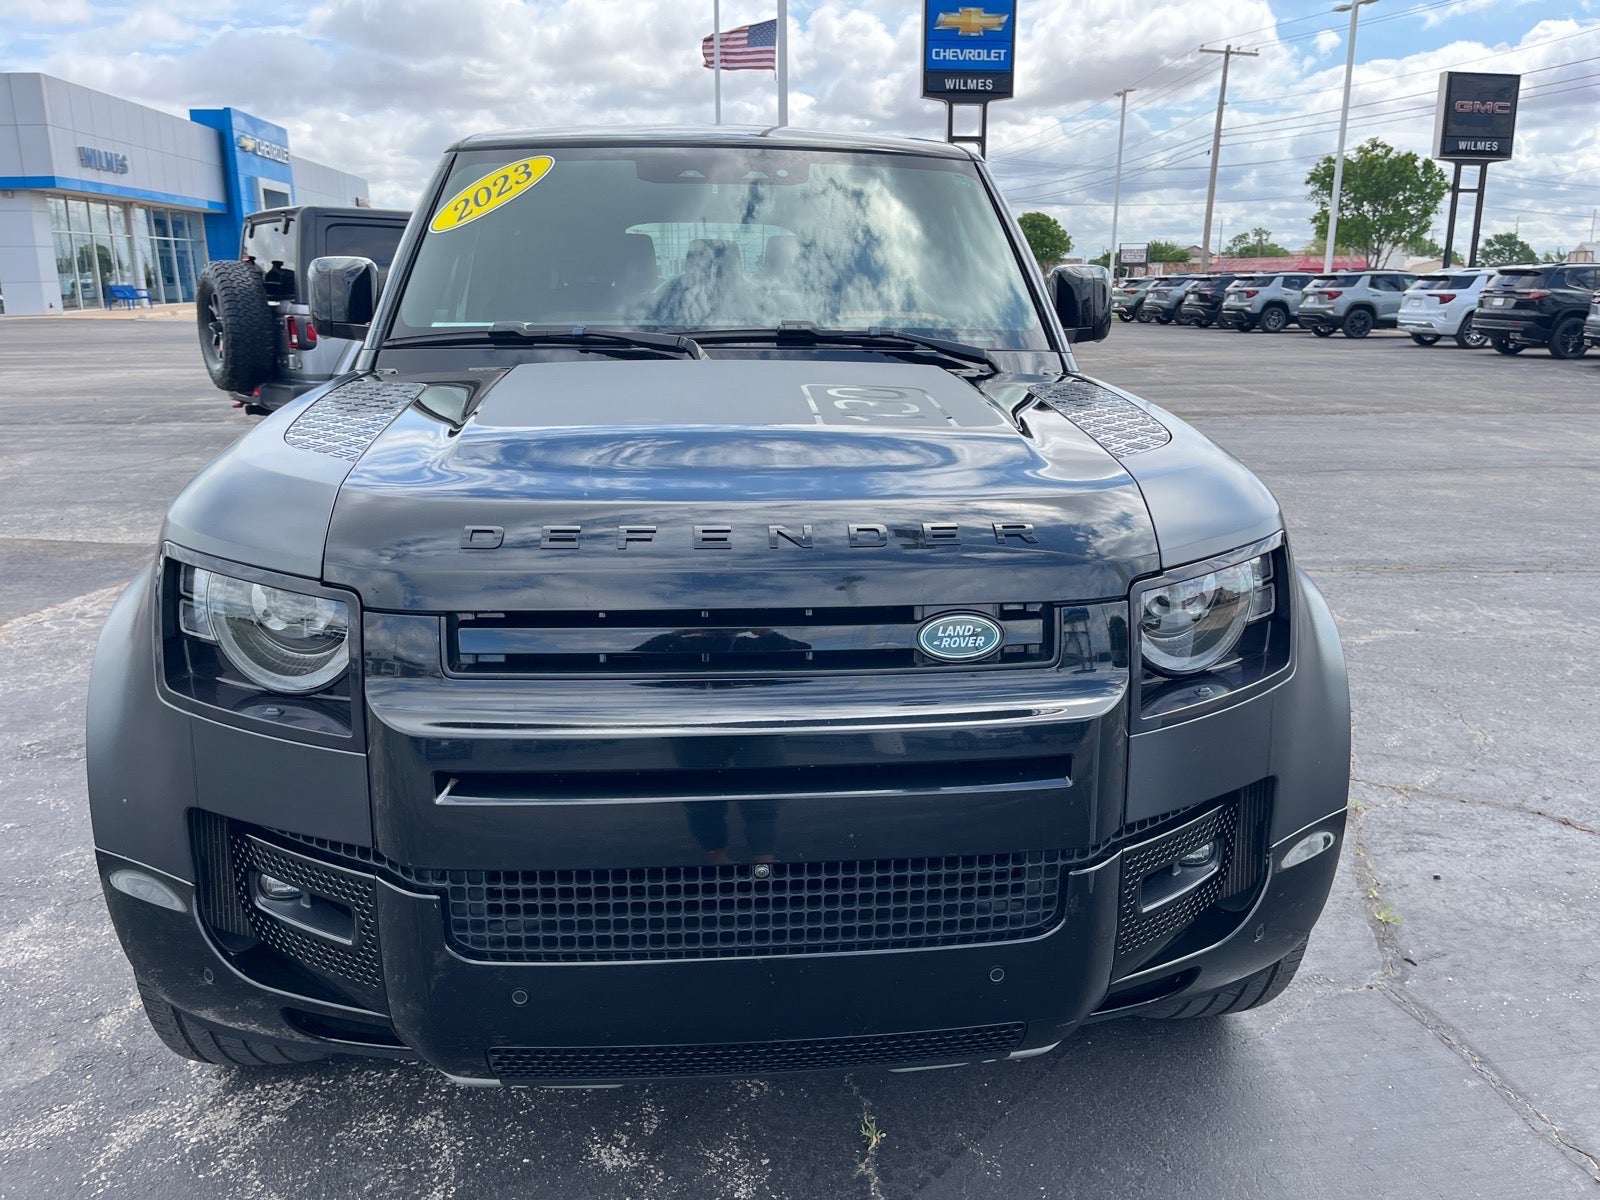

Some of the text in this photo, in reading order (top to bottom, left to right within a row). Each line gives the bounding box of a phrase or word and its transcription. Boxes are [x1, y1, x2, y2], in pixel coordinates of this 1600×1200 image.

[931, 48, 1007, 61] CHEVROLET
[944, 78, 994, 91] WILMES
[1455, 100, 1511, 114] GMC
[256, 139, 290, 164] CHEVROLE
[1458, 140, 1499, 152] WILMES
[453, 163, 533, 223] 2023
[460, 522, 1039, 550] DEFENDER
[937, 625, 974, 637] LAND
[940, 636, 985, 649] ROVER
